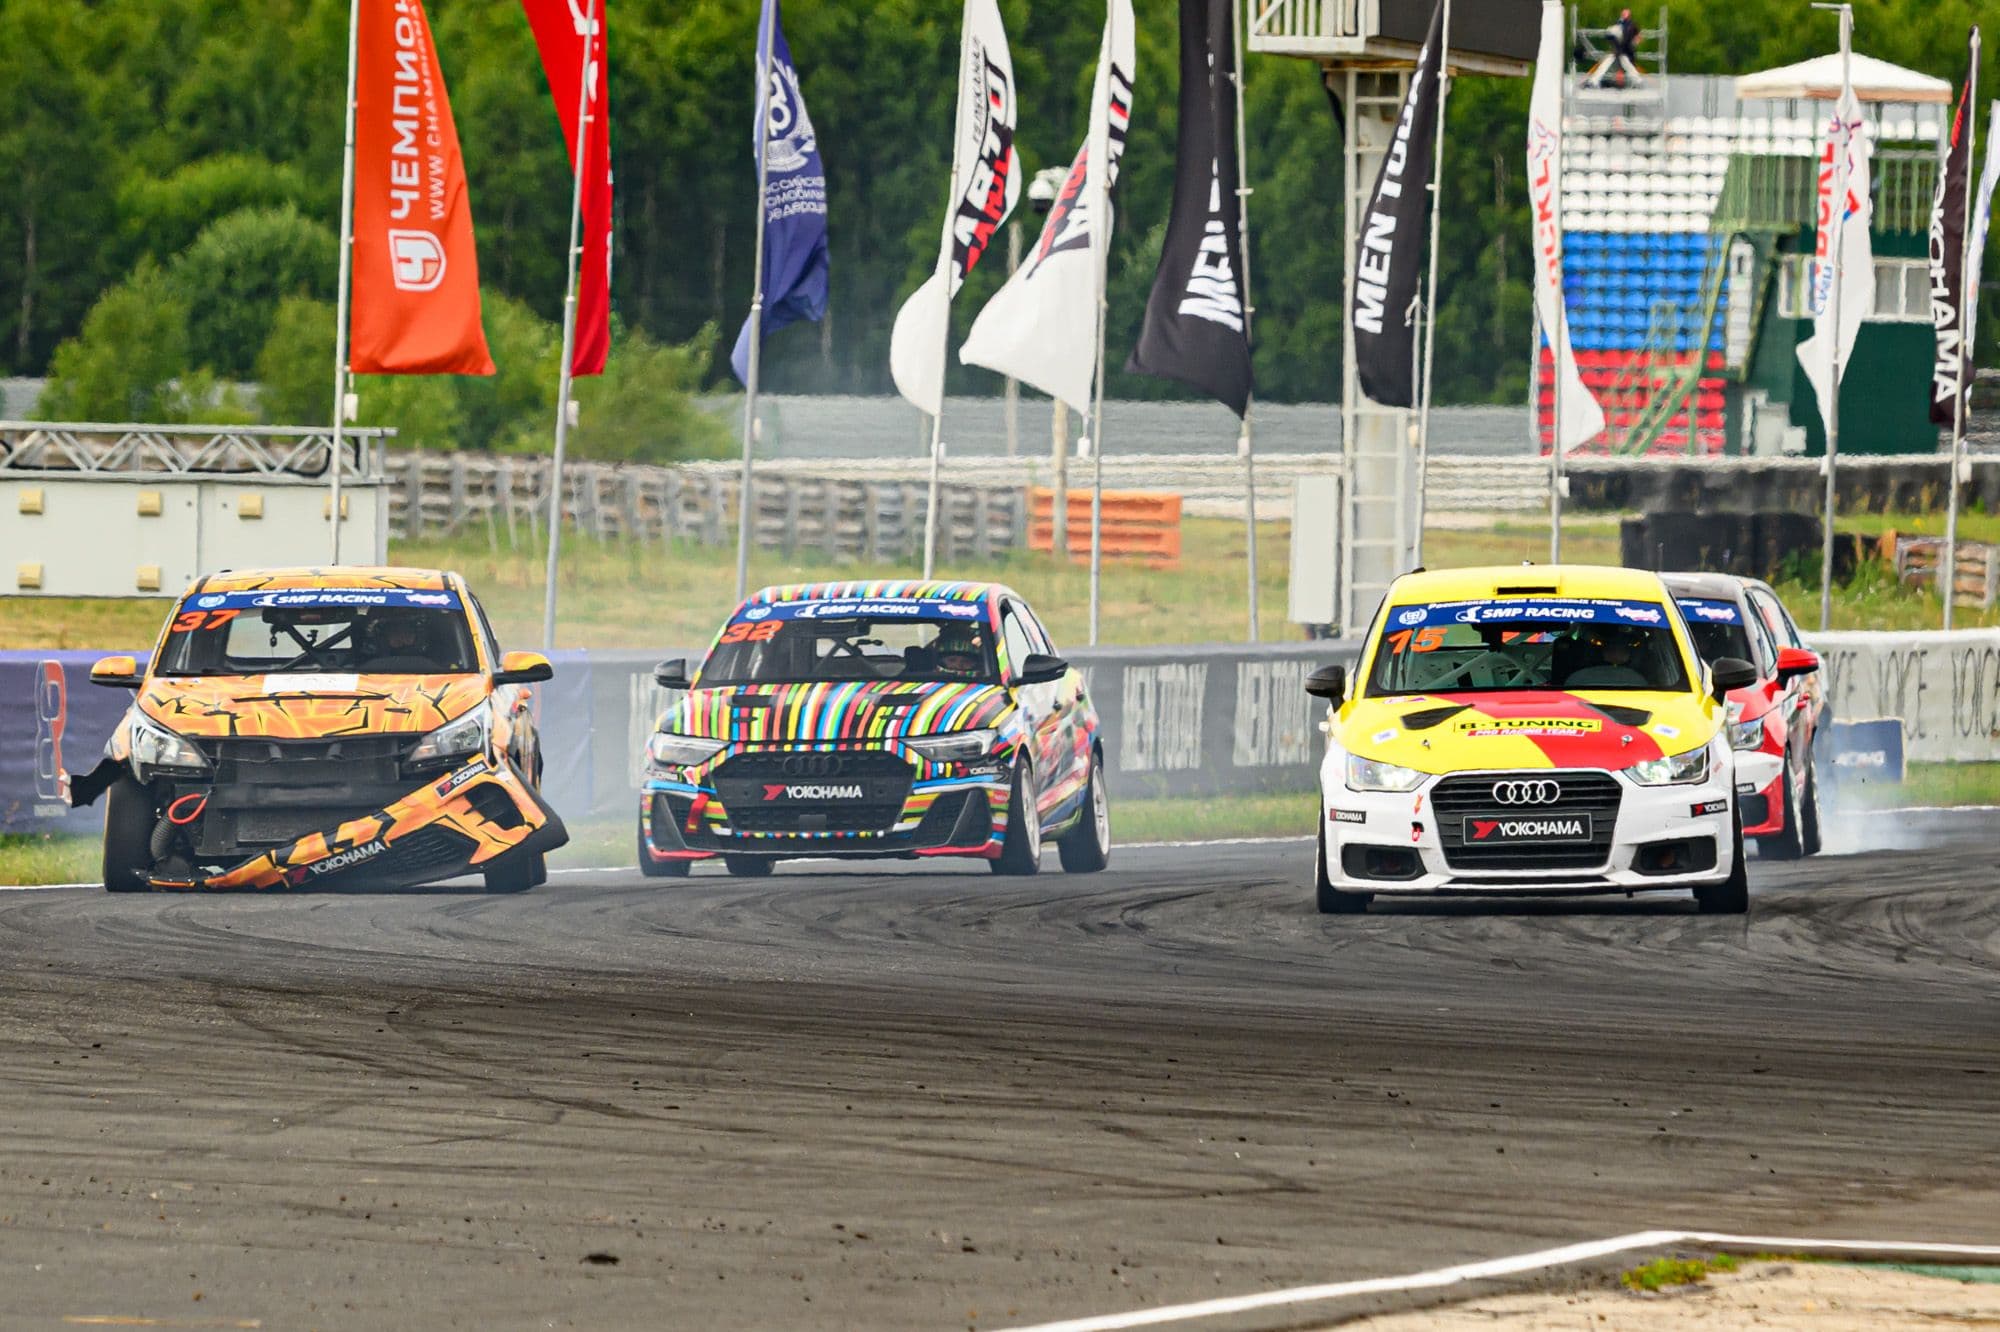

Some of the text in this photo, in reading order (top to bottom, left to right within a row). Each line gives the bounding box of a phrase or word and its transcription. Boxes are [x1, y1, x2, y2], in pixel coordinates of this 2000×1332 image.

[1354, 211, 1397, 335] MEN
[276, 594, 386, 604] SMP RACING
[818, 604, 920, 615] SMP RACING
[1481, 607, 1595, 620] SMP RACING
[171, 609, 241, 633] 37
[719, 620, 784, 644] 32
[1388, 627, 1449, 655] 15
[1501, 728, 1543, 736] RACING
[1546, 728, 1577, 736] TEAM
[450, 763, 487, 786] YOKOHAMA
[785, 784, 863, 800] YOKOHAMA
[1498, 820, 1583, 837] YOKOHAMA
[309, 840, 386, 875] YOKOHAMA
